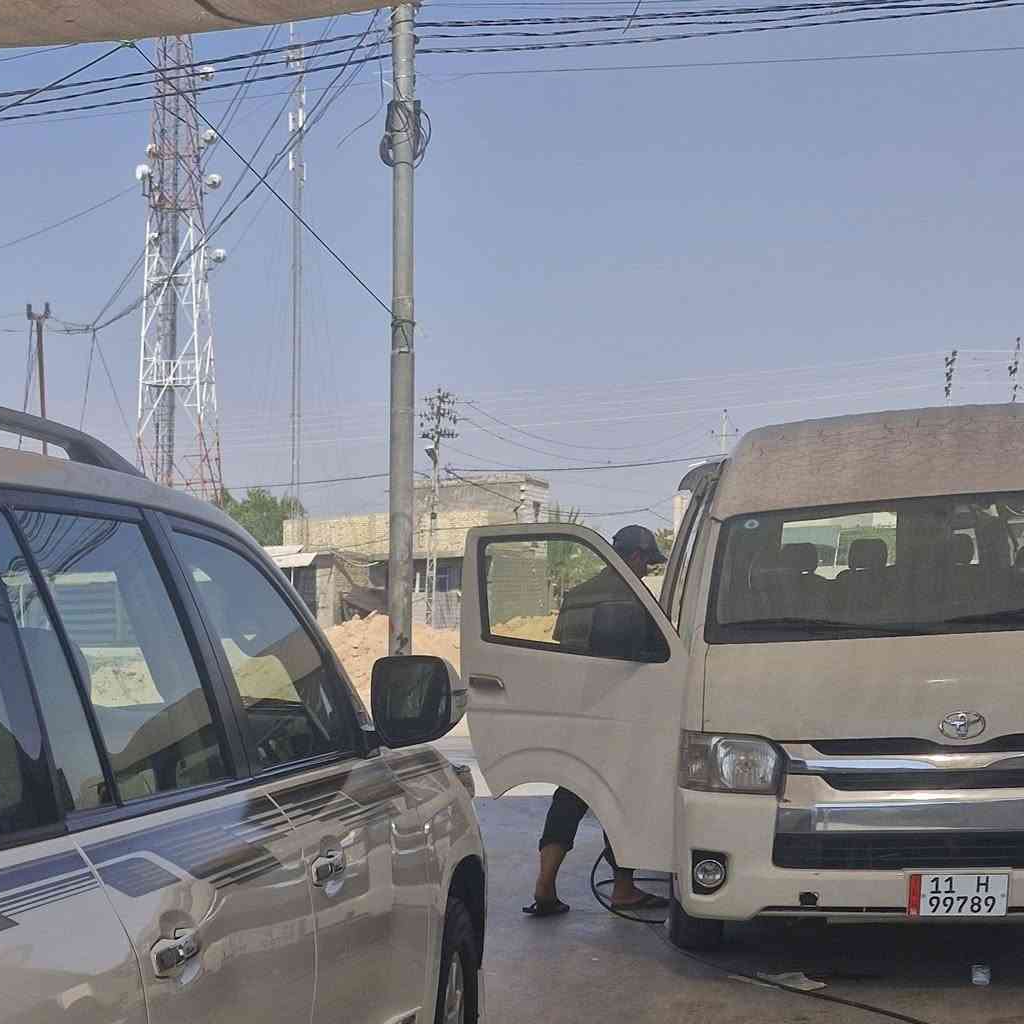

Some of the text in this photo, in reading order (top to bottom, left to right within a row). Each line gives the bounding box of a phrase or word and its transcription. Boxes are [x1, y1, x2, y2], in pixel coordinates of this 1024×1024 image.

[930, 875, 989, 894] 11 H
[929, 896, 996, 913] 99789
